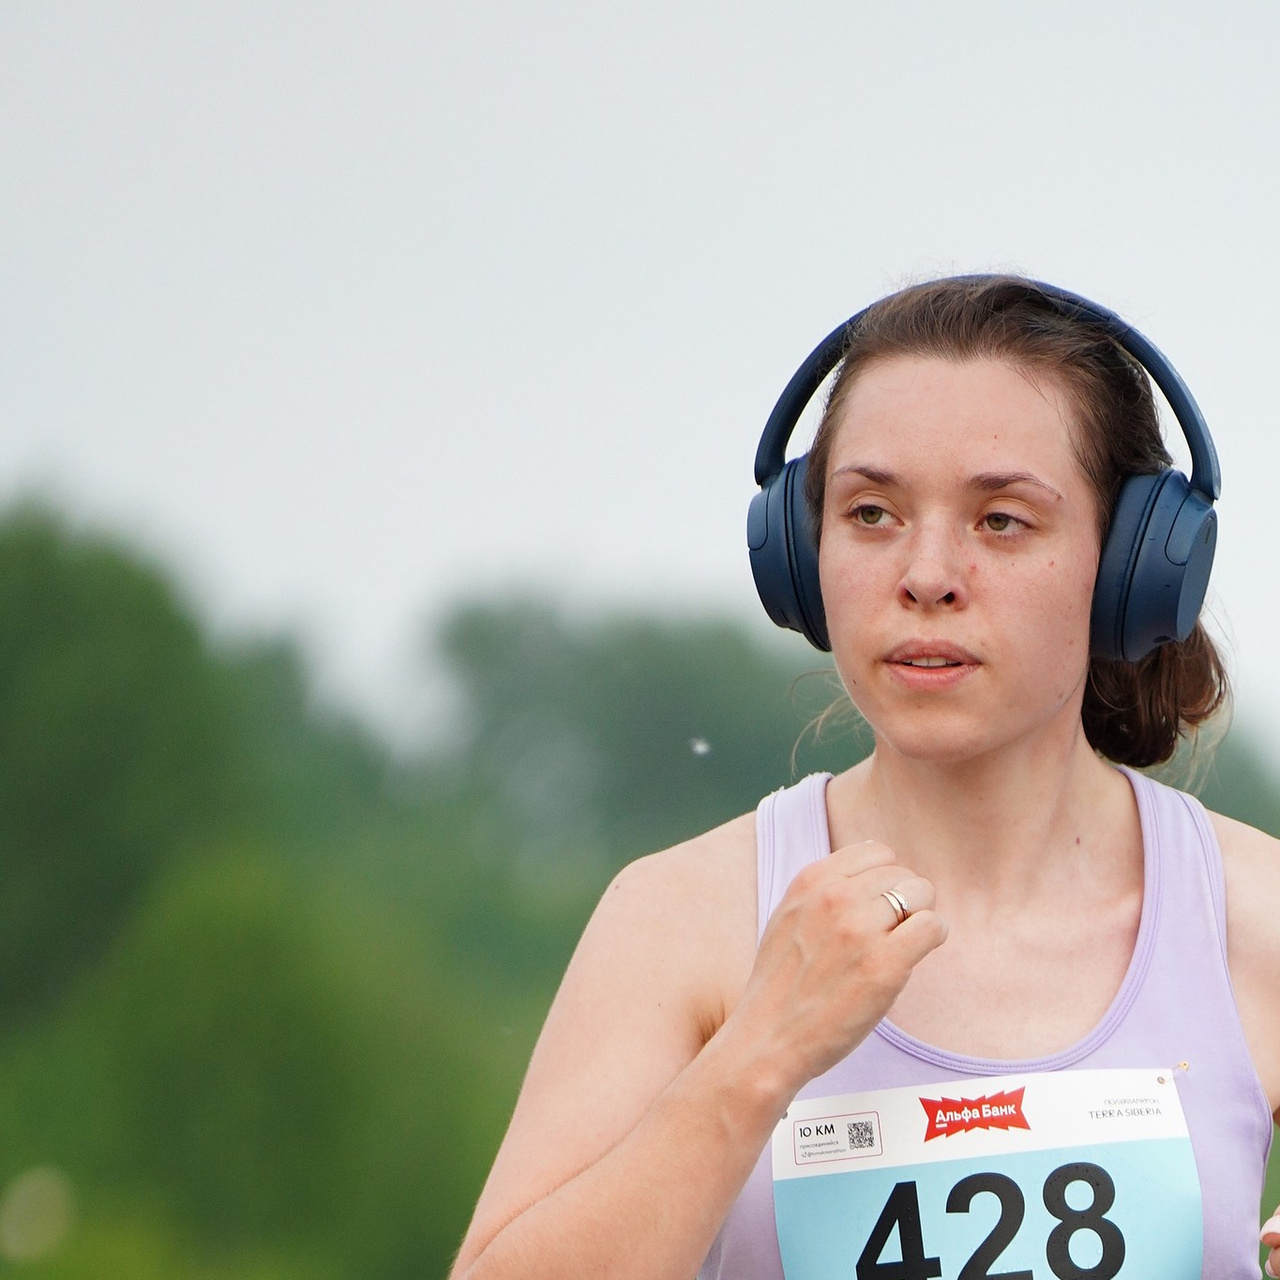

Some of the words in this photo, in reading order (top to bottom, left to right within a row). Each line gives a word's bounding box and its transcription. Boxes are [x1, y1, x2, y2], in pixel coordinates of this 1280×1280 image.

[935, 1107, 980, 1123] Альфа
[981, 1104, 1016, 1118] Банк
[1088, 1109, 1123, 1120] TERRA
[1125, 1107, 1162, 1117] SIBERIA
[799, 1126, 812, 1138] 10
